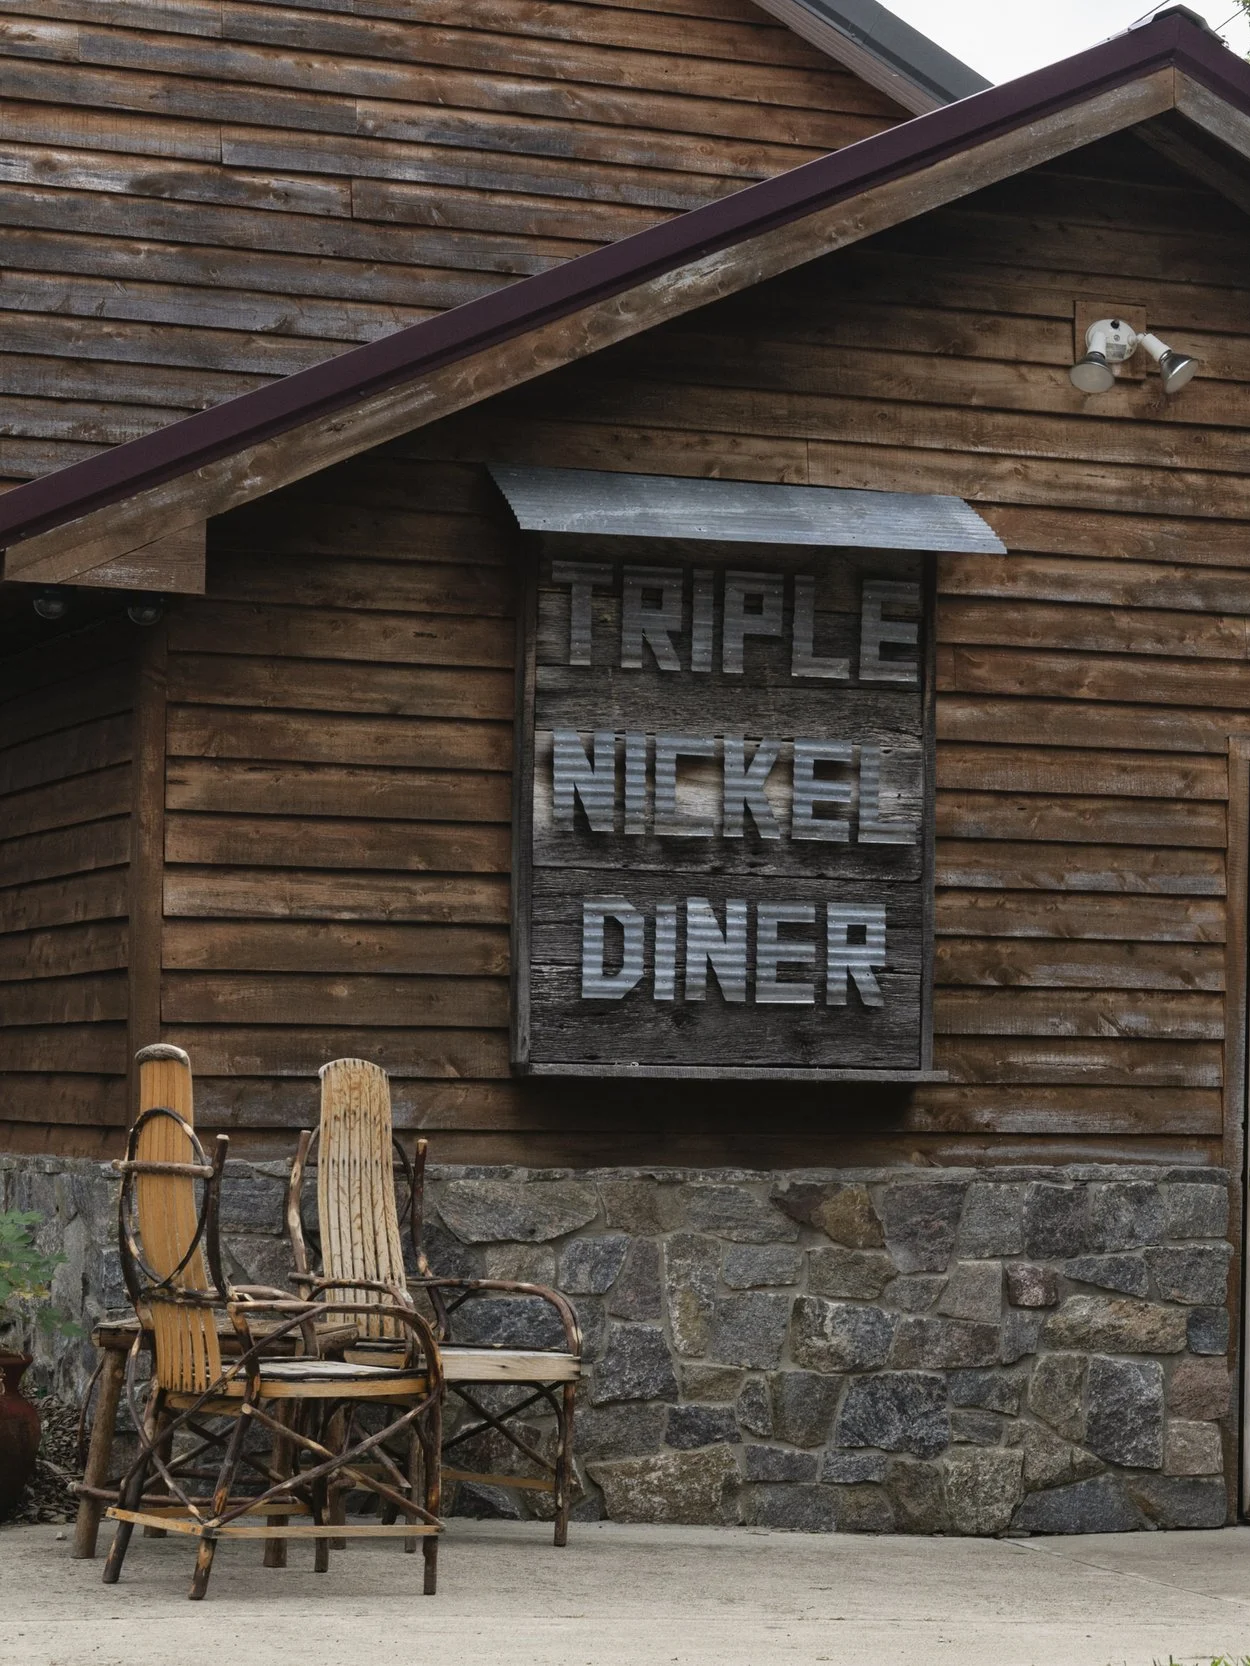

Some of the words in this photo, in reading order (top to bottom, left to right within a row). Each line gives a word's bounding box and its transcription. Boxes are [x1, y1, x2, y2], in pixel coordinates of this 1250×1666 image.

[552, 560, 919, 682] TRIPLE
[552, 728, 917, 844] NICKEL
[581, 894, 886, 1006] DINER
